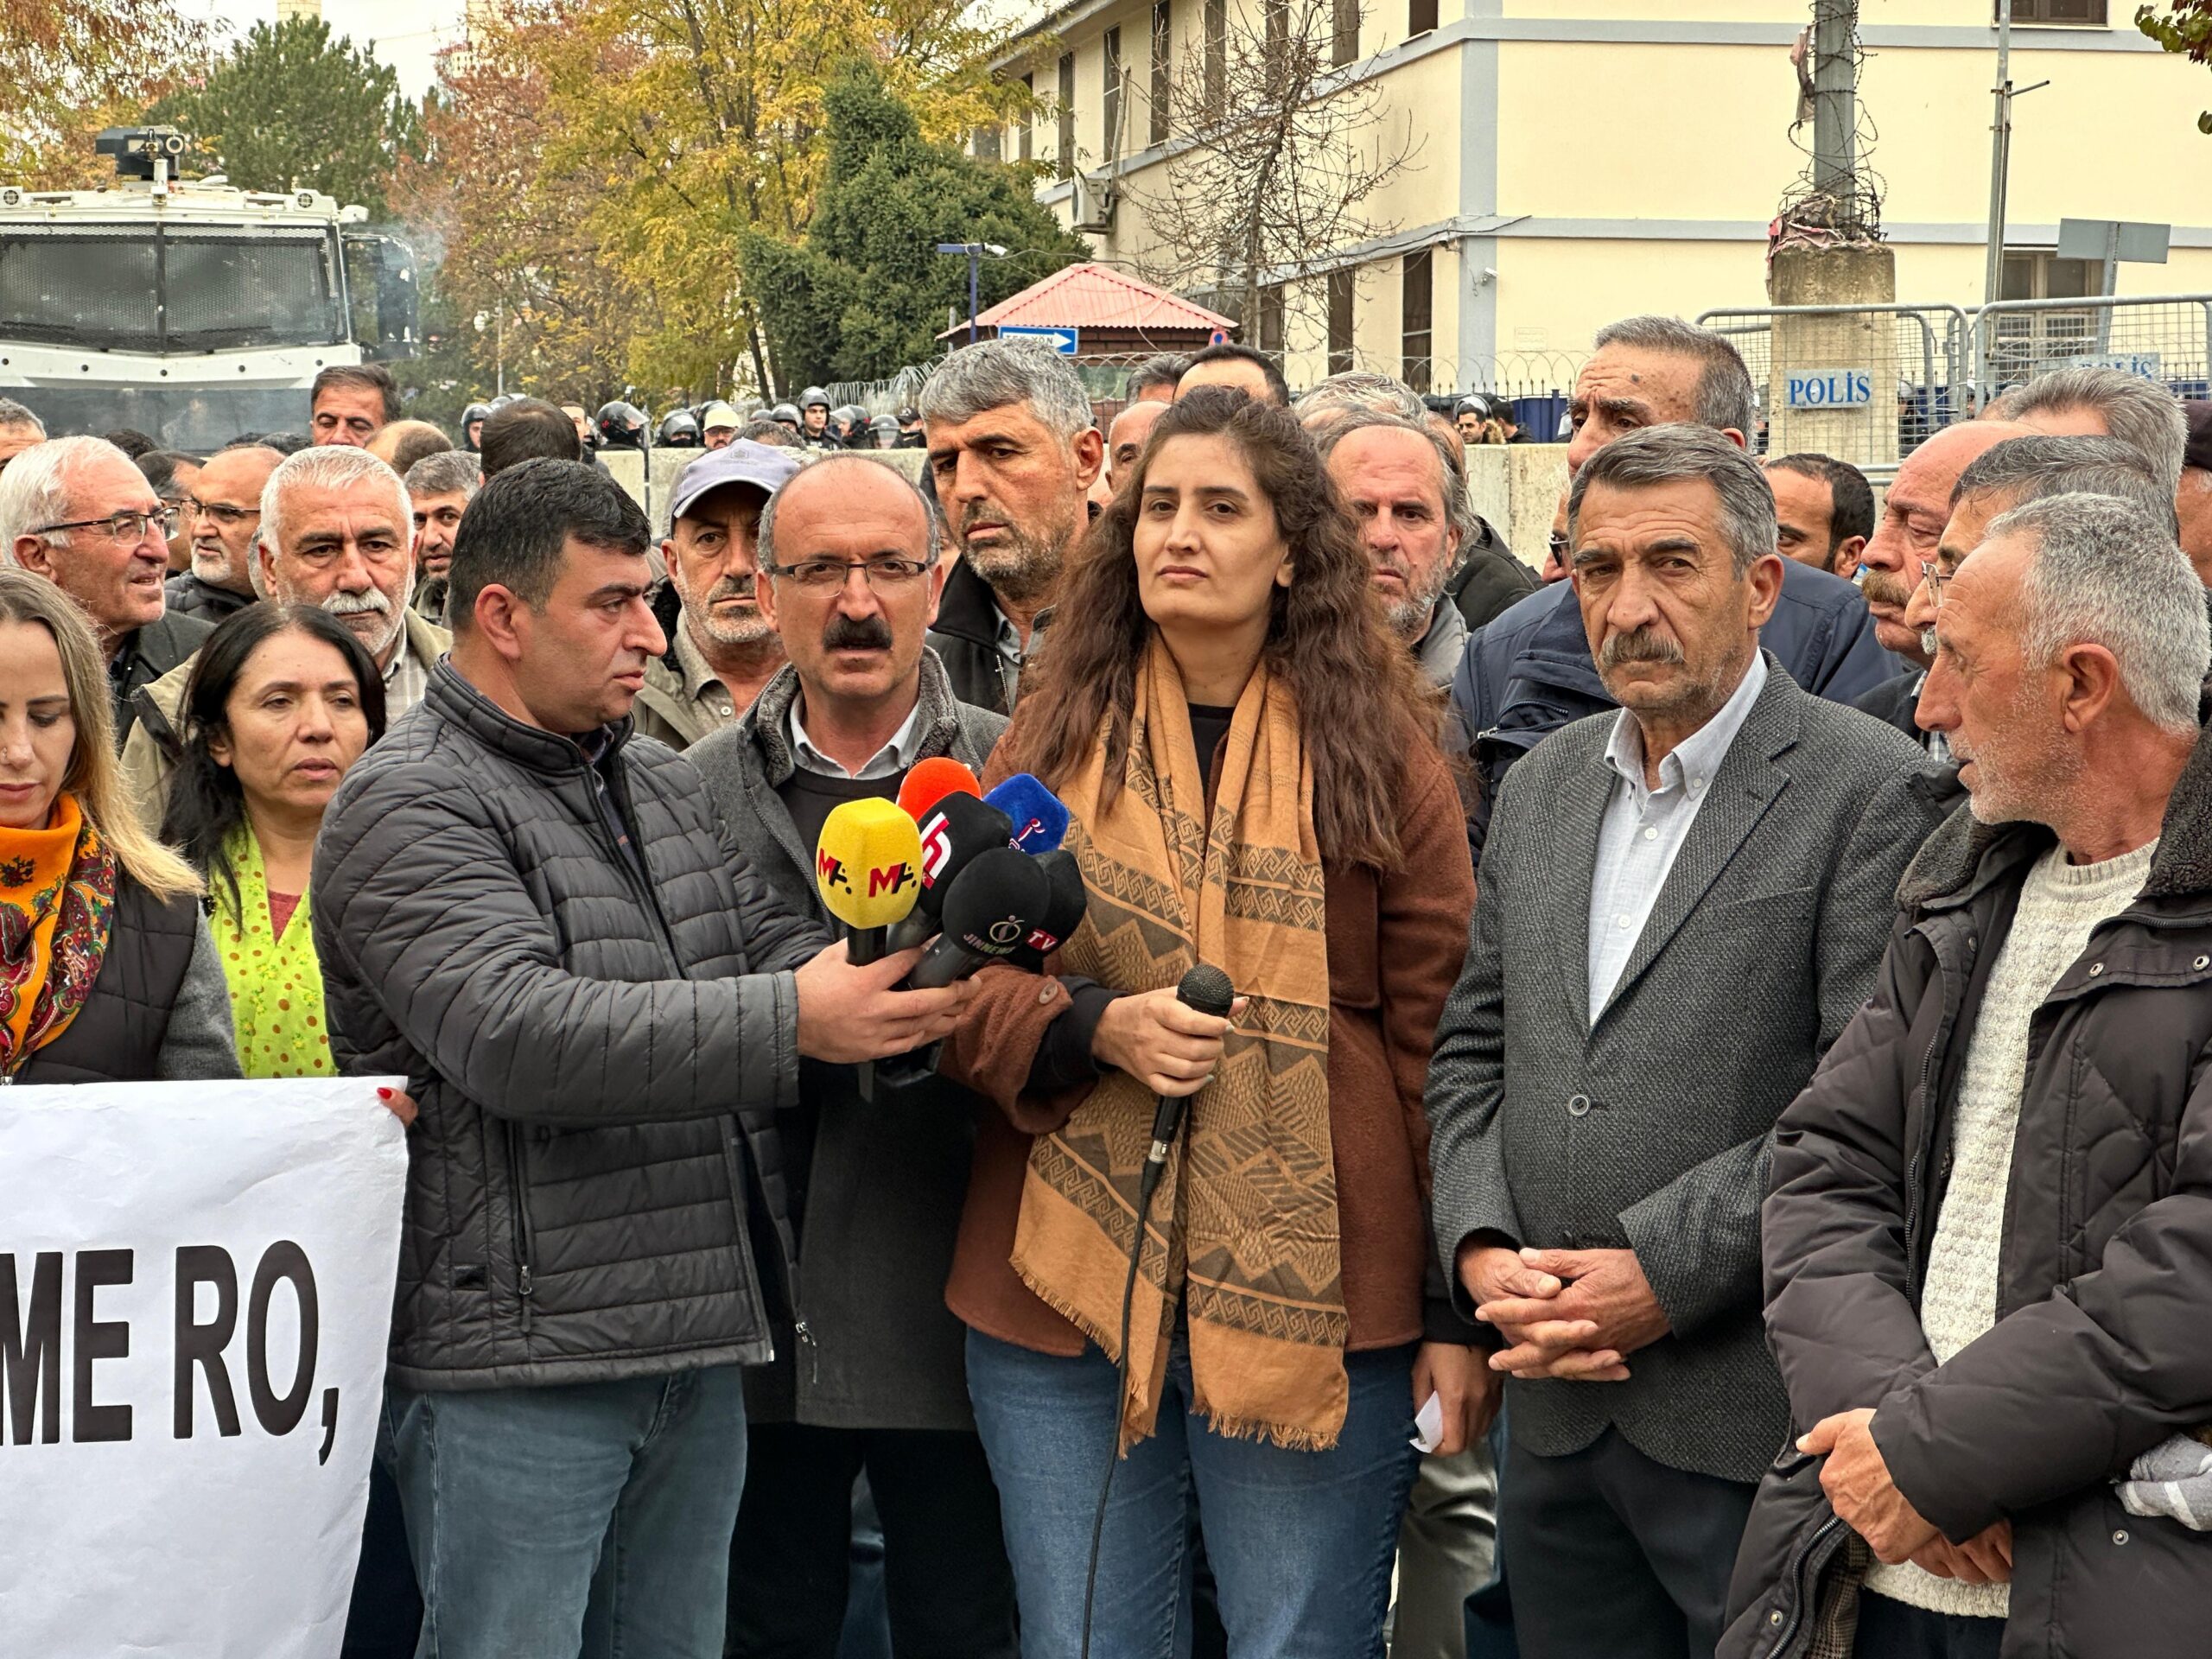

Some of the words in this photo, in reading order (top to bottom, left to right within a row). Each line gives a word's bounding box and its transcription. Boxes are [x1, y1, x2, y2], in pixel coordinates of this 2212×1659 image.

[1789, 372, 1871, 404] POLİS
[1028, 931, 1056, 950] TV
[0, 1249, 134, 1446] ME
[174, 1239, 340, 1466] RO,
